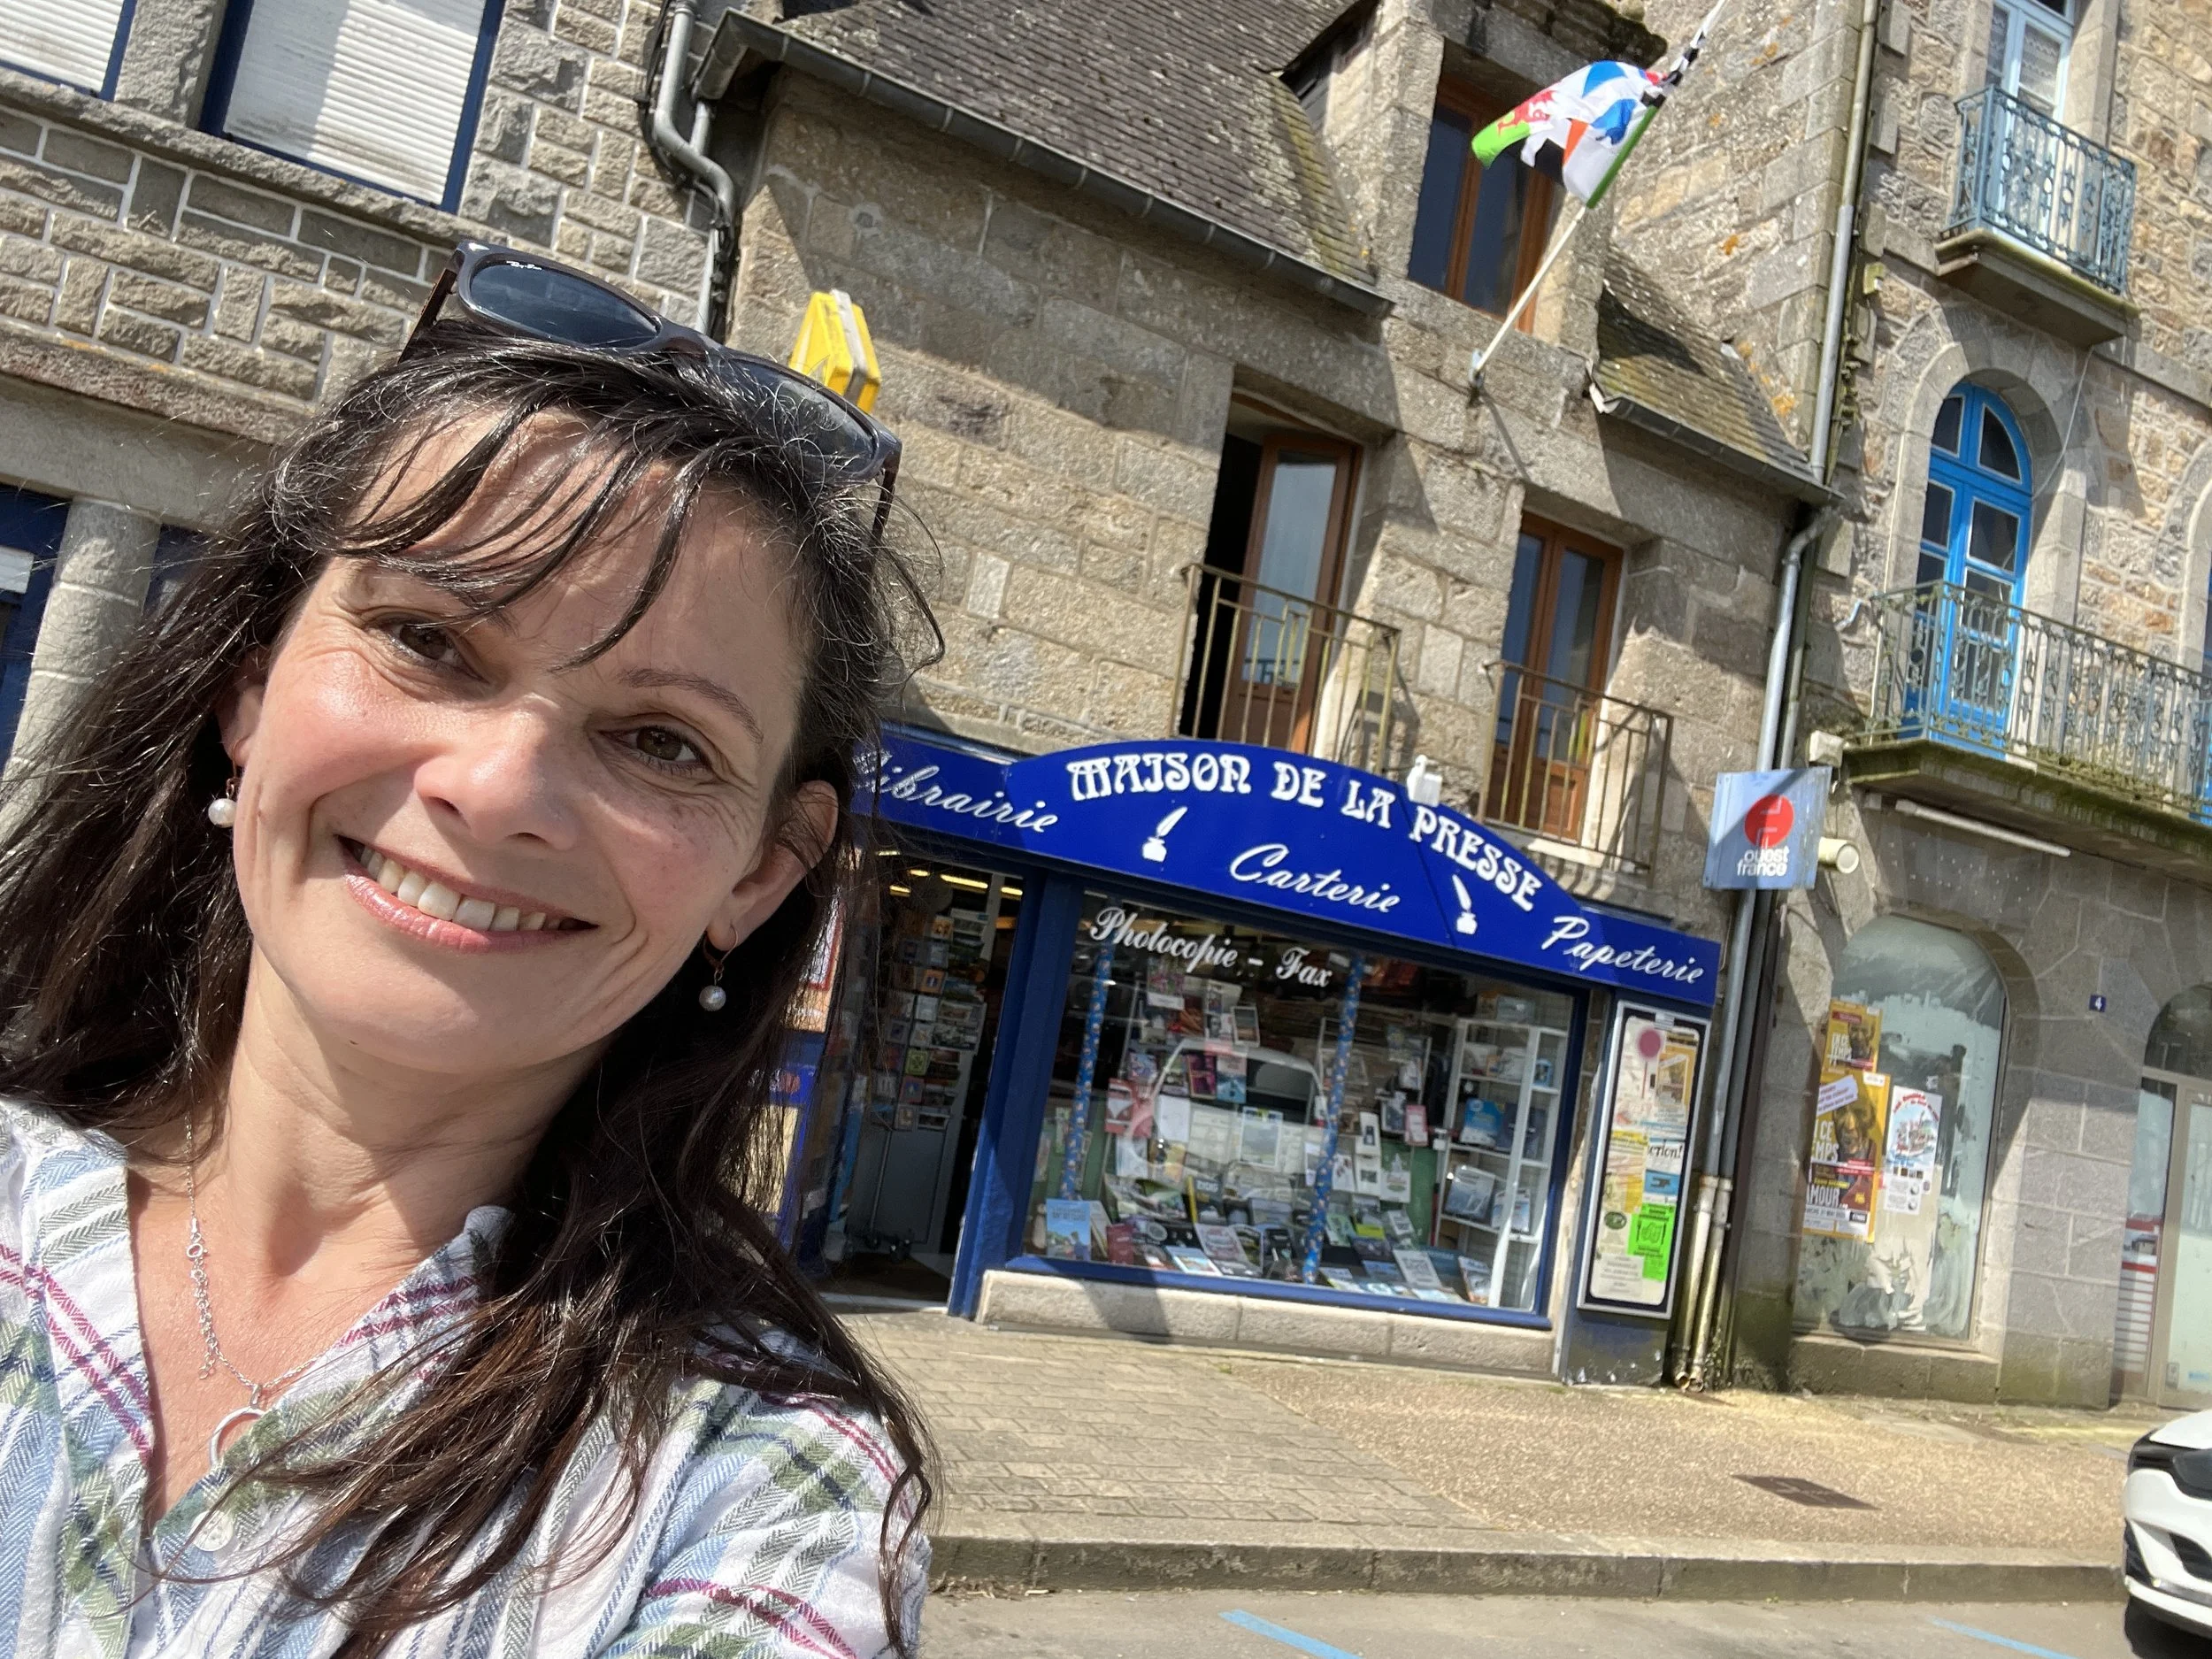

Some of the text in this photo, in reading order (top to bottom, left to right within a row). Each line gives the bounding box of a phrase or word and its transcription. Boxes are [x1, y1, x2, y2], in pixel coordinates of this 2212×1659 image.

[1066, 752, 1543, 911] MAISON DE LA PRESSE
[1229, 843, 1401, 913] Carterie
[1737, 860, 1787, 876] france
[1090, 907, 1238, 972] Photocopie
[1276, 946, 1332, 987] Fax
[1540, 916, 1704, 984] Papeterie
